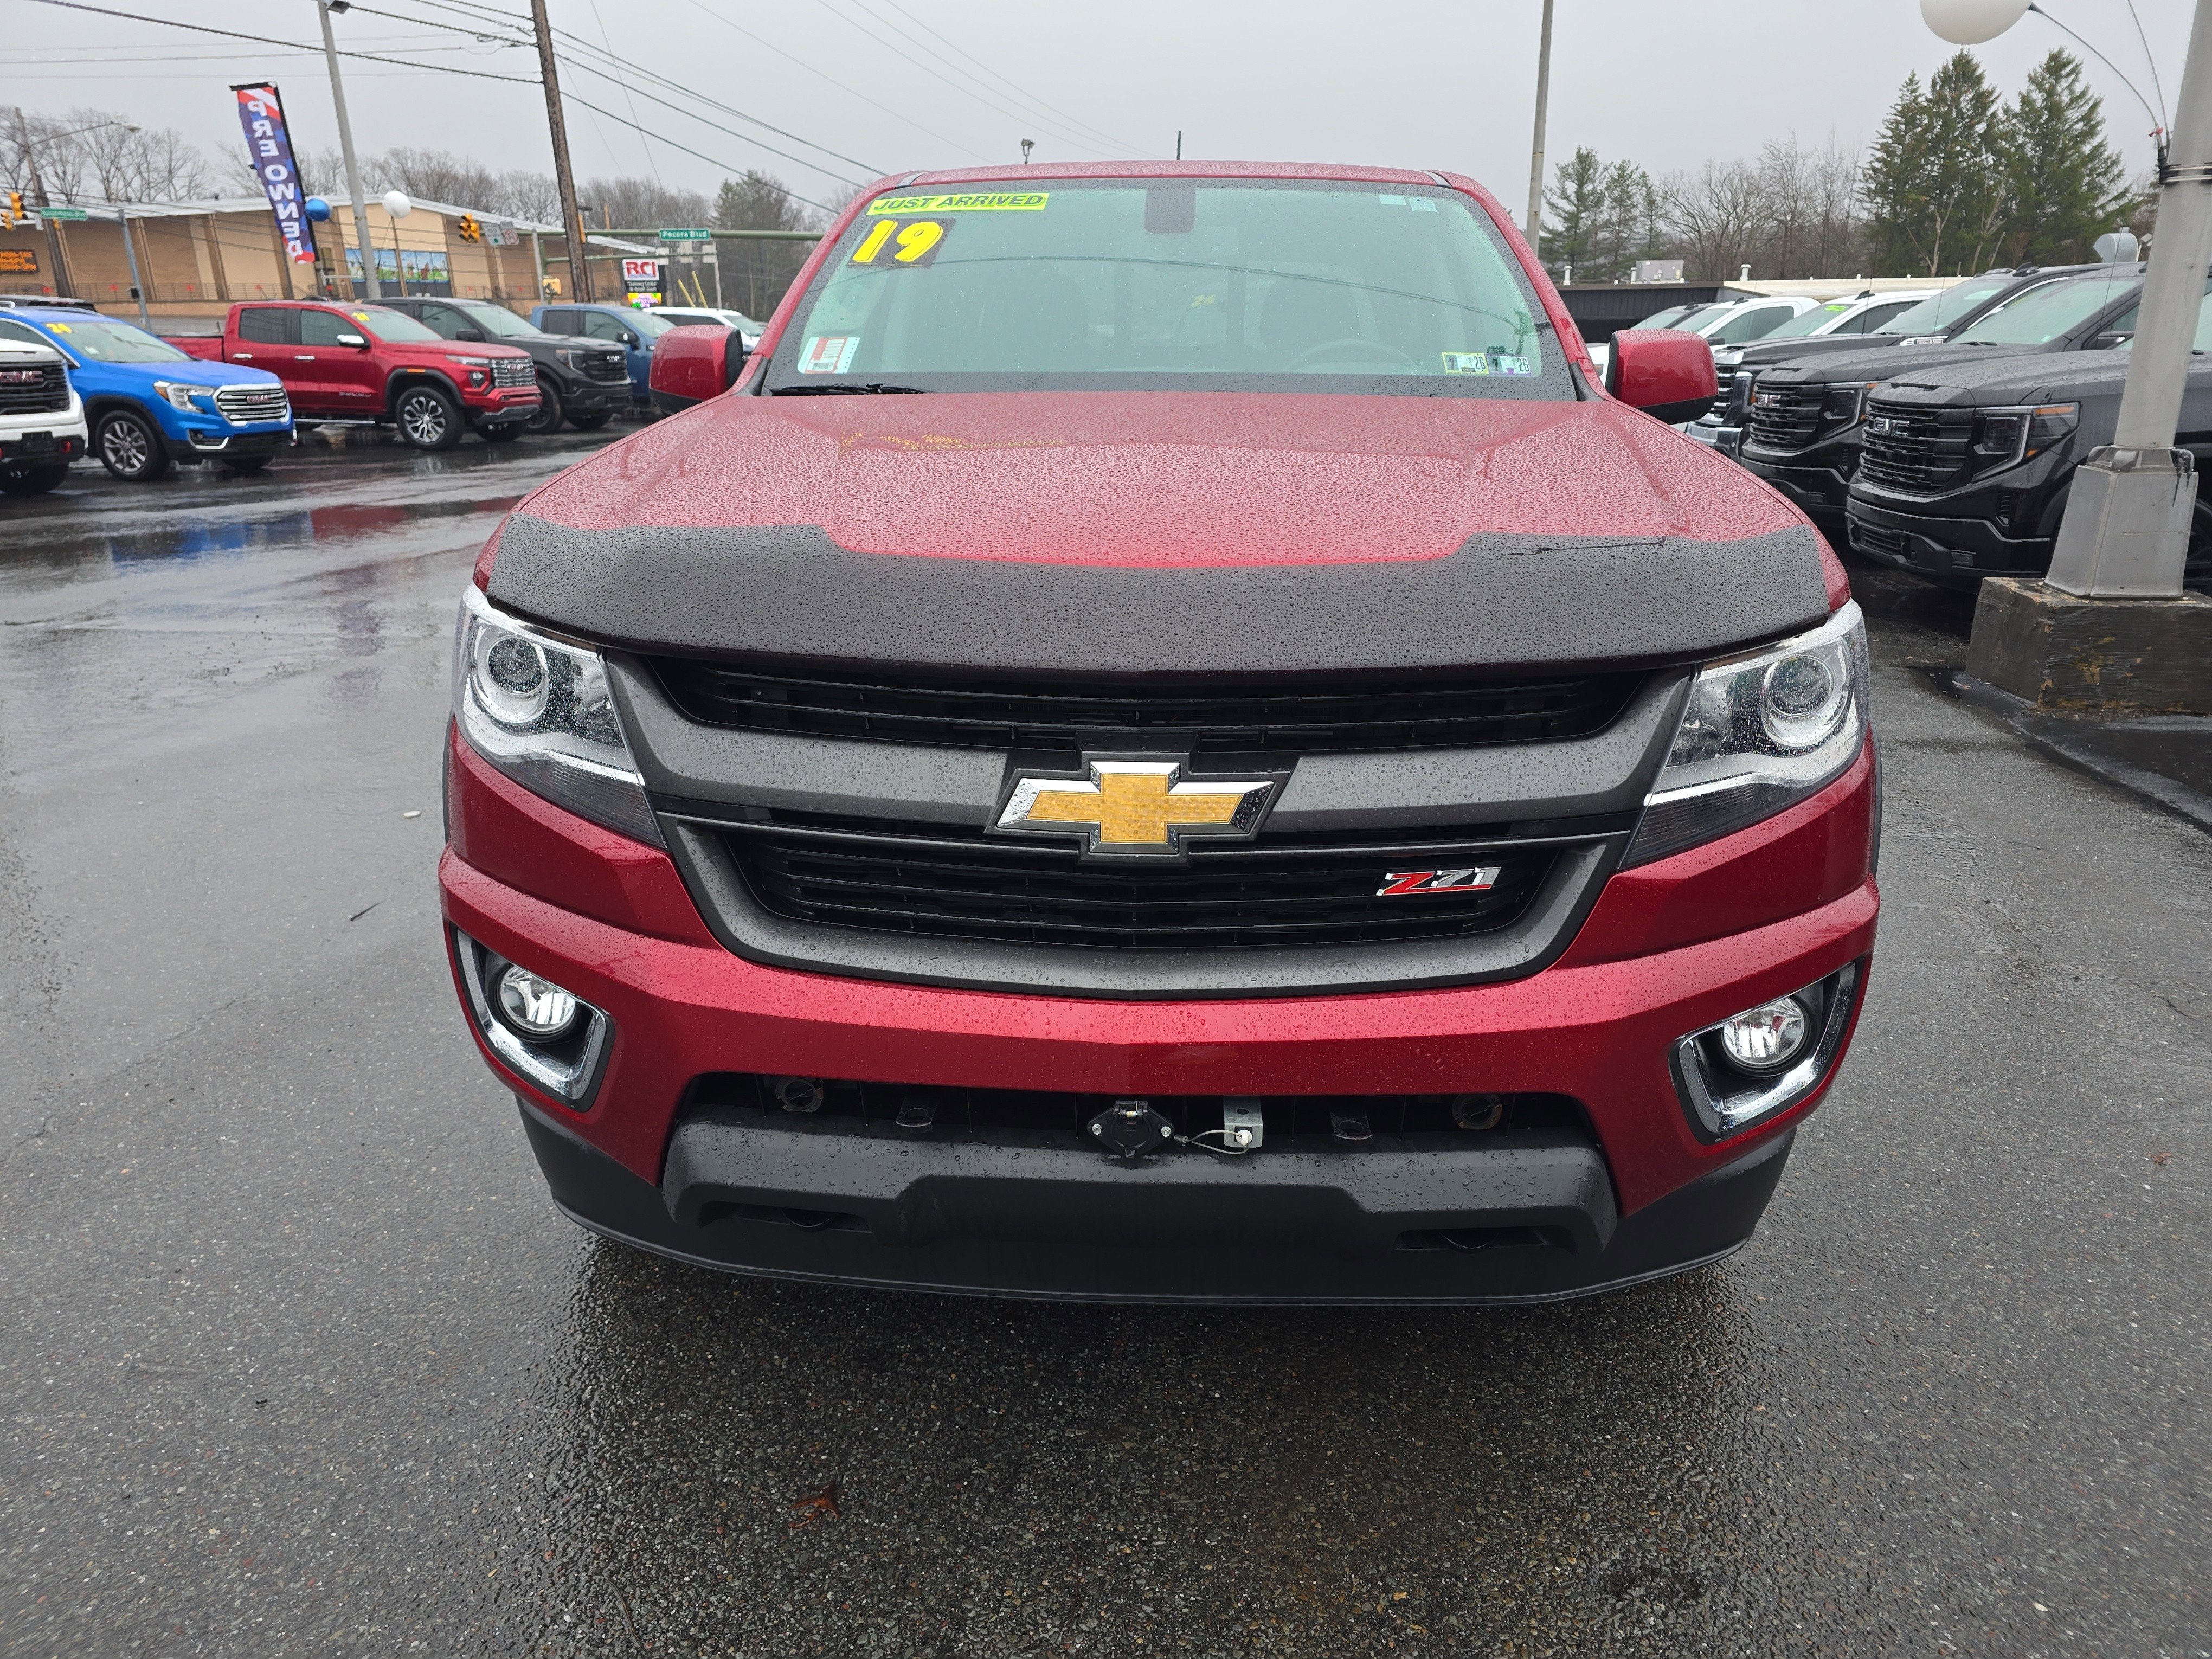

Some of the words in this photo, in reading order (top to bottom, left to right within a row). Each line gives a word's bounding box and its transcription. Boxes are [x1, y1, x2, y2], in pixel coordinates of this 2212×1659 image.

[873, 197, 936, 211] JUST
[937, 195, 1046, 208] ARRIVED
[852, 218, 944, 263] 19
[626, 261, 657, 277] RCI
[1473, 356, 1486, 370] 26
[1517, 358, 1529, 372] 26
[0, 371, 44, 383] GMC
[1873, 417, 1910, 438] GMC
[1375, 866, 1502, 896] Z71
